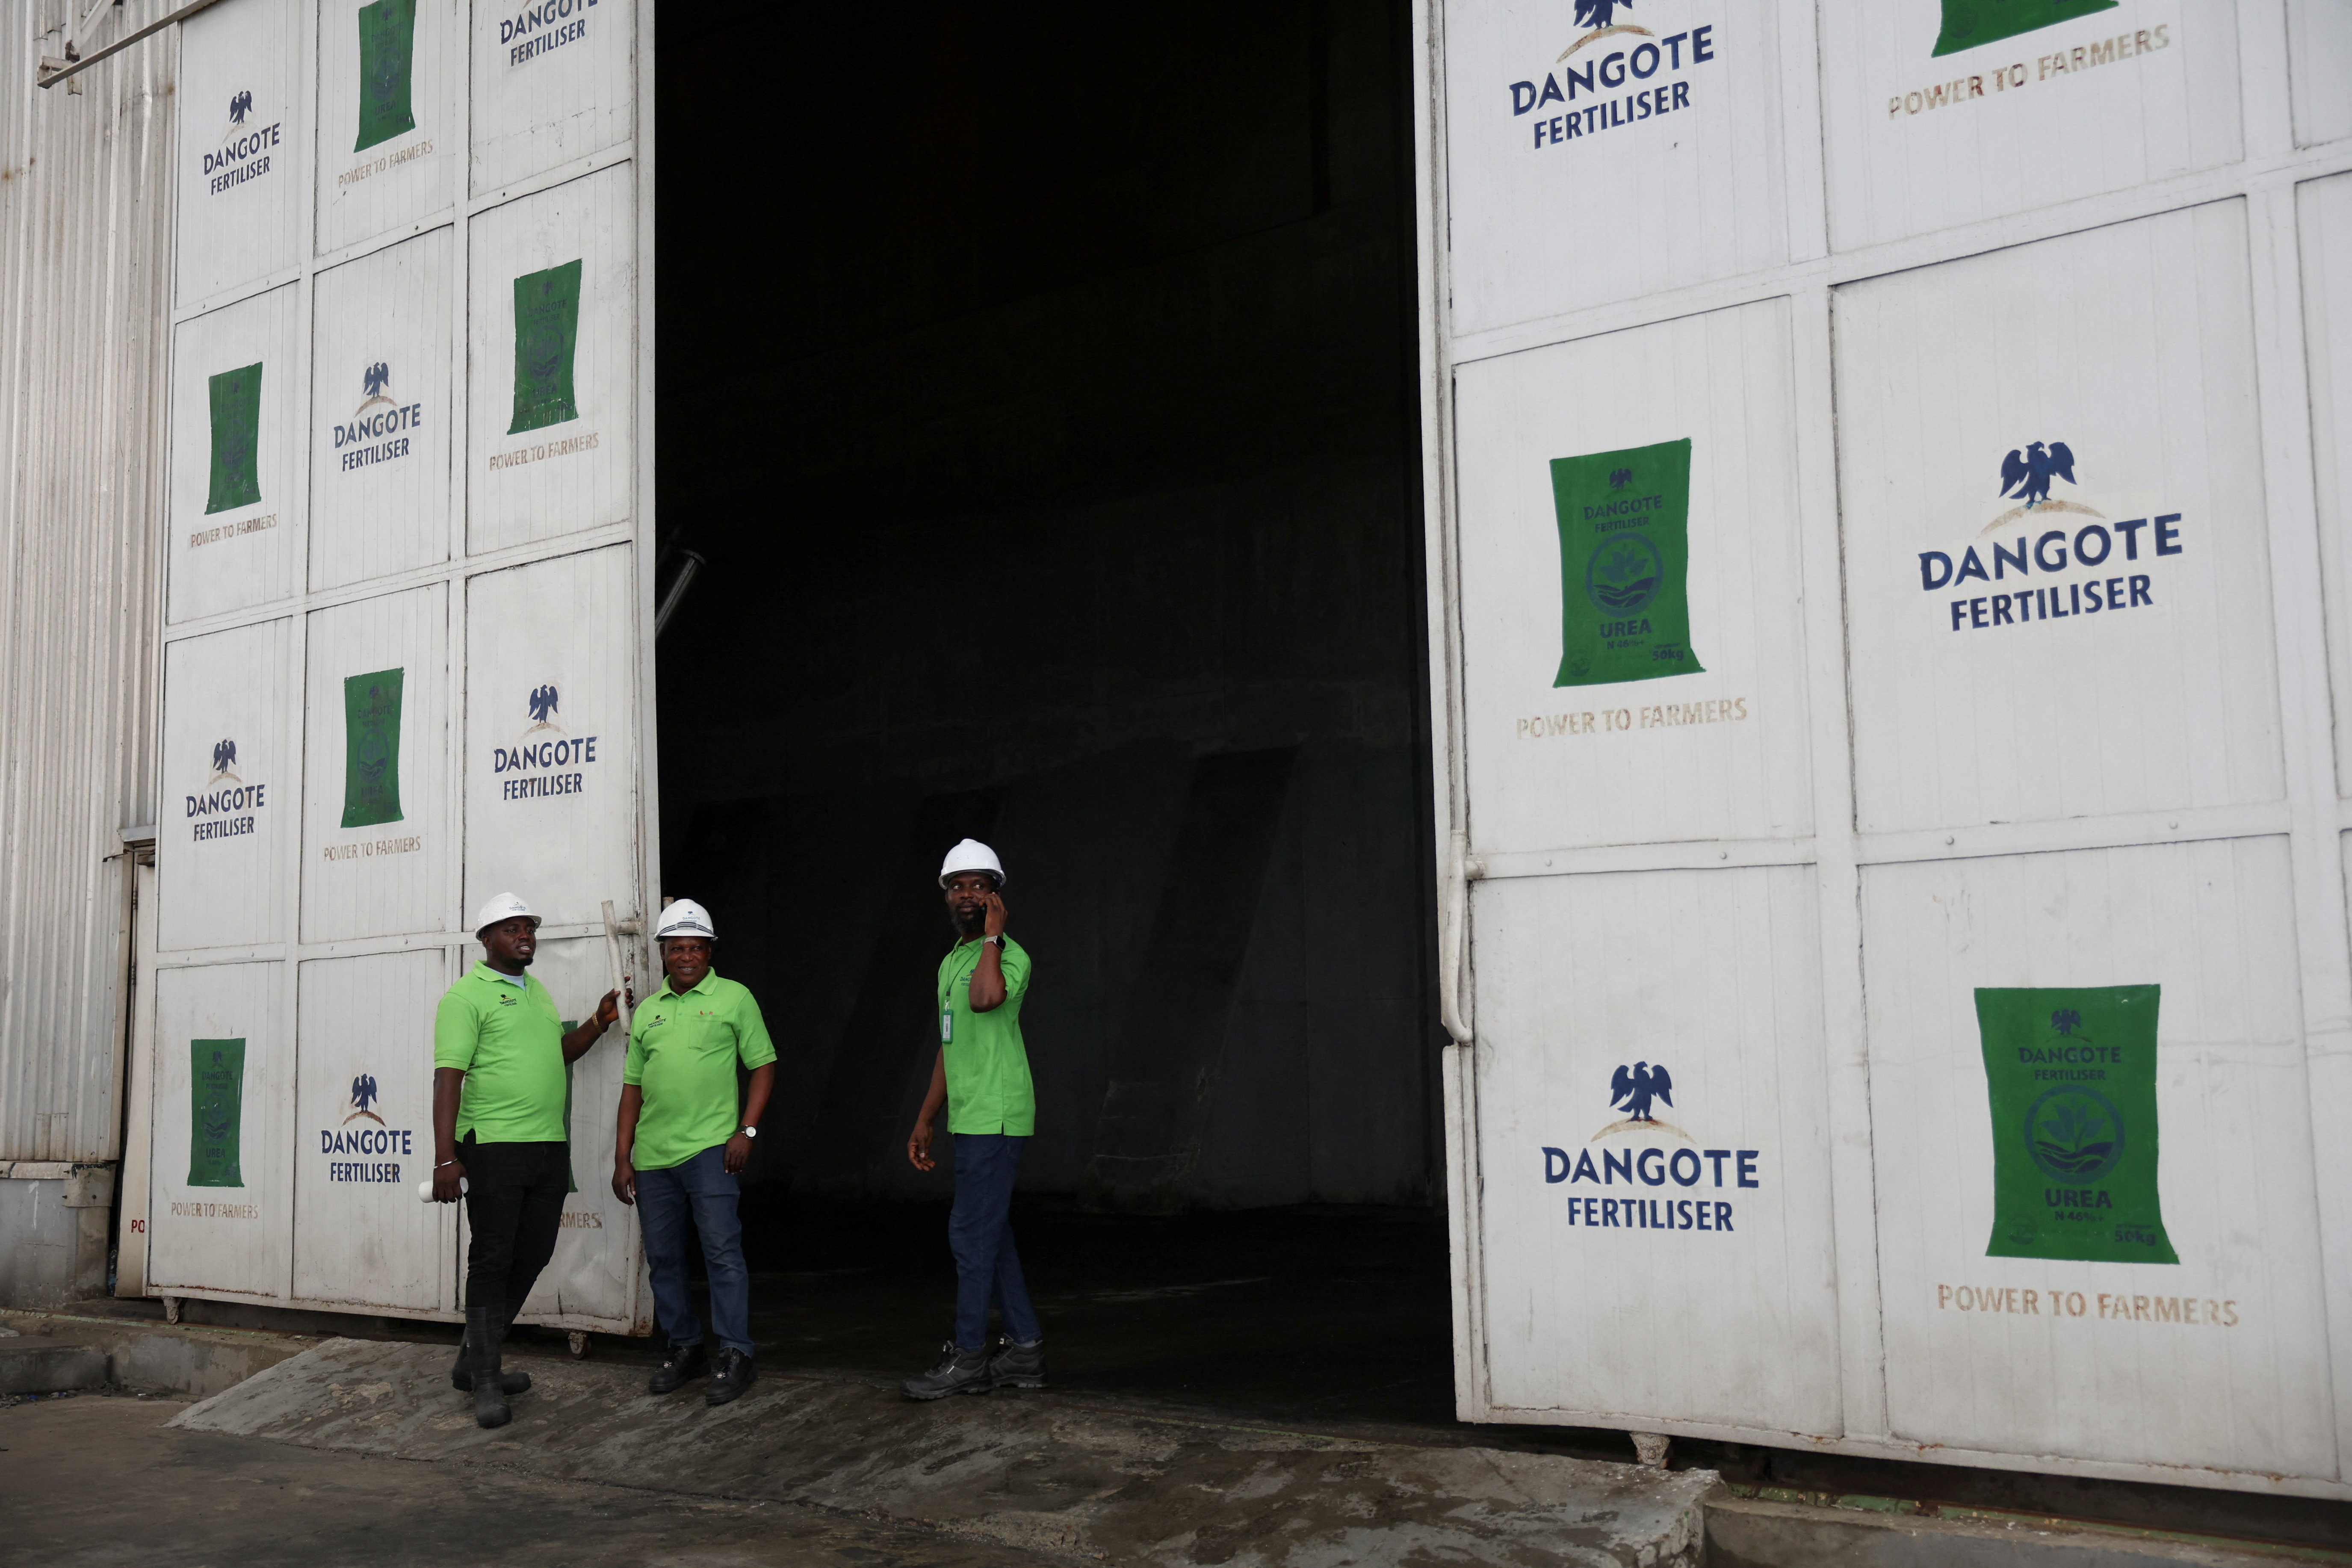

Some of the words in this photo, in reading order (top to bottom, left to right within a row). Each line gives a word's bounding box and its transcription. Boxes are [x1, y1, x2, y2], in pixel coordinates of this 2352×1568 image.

[511, 19, 585, 67] FERTILISER
[1509, 24, 1714, 117] DANGOTE
[1888, 76, 1985, 120] POWER
[1992, 63, 2027, 92] TO
[2037, 24, 2170, 81] FARMERS
[1534, 81, 1690, 150] FERTILISER
[204, 122, 280, 175] DANGOTE
[339, 164, 371, 188] POWER
[374, 158, 386, 174] TO
[390, 139, 433, 168] FARMERS
[211, 156, 270, 195] FERTILISER
[334, 403, 420, 449] DANGOTE
[343, 438, 409, 472] FERTILISER
[490, 449, 528, 471] POWER
[530, 446, 544, 461] TO
[548, 432, 598, 458] FARMERS
[1584, 495, 1662, 520] DANGOTE
[191, 528, 220, 548] POWER
[223, 525, 234, 539] TO
[237, 514, 278, 536] FARMERS
[1595, 517, 1649, 533] FERTILISER
[1918, 513, 2183, 591] DANGOTE
[1950, 574, 2154, 632] FERTILISER
[1600, 619, 1652, 638] UREA
[1652, 649, 1684, 661] 50kg
[1516, 712, 1595, 739] POWER
[1601, 709, 1631, 732] TO
[1639, 697, 1746, 728] FARMERS
[494, 737, 597, 773] DANGOTE
[186, 784, 265, 818] DANGOTE
[504, 773, 582, 800] FERTILISER
[194, 816, 254, 841] FERTILISER
[324, 844, 358, 862] POWER
[361, 842, 373, 857] TO
[376, 836, 421, 856] FARMERS
[2018, 1047, 2122, 1064] DANGOTE
[202, 1071, 233, 1081] DANGOTE
[2034, 1070, 2106, 1080] FERTILISER
[206, 1148, 225, 1158] UREA
[321, 1130, 412, 1155] DANGOTE
[331, 1163, 400, 1183] FERTILISER
[1541, 1147, 1759, 1188] DANGOTE
[171, 1202, 201, 1217] POWER
[204, 1203, 215, 1217] TO
[218, 1204, 258, 1219] FARMERS
[1567, 1197, 1734, 1231] FERTILISER
[2045, 1189, 2112, 1208] UREA
[559, 1212, 601, 1228] RMERS
[2115, 1230, 2156, 1246] 50kg
[1938, 1284, 2040, 1315] POWER
[2048, 1290, 2086, 1317] TO
[2097, 1293, 2240, 1327] FARMERS
